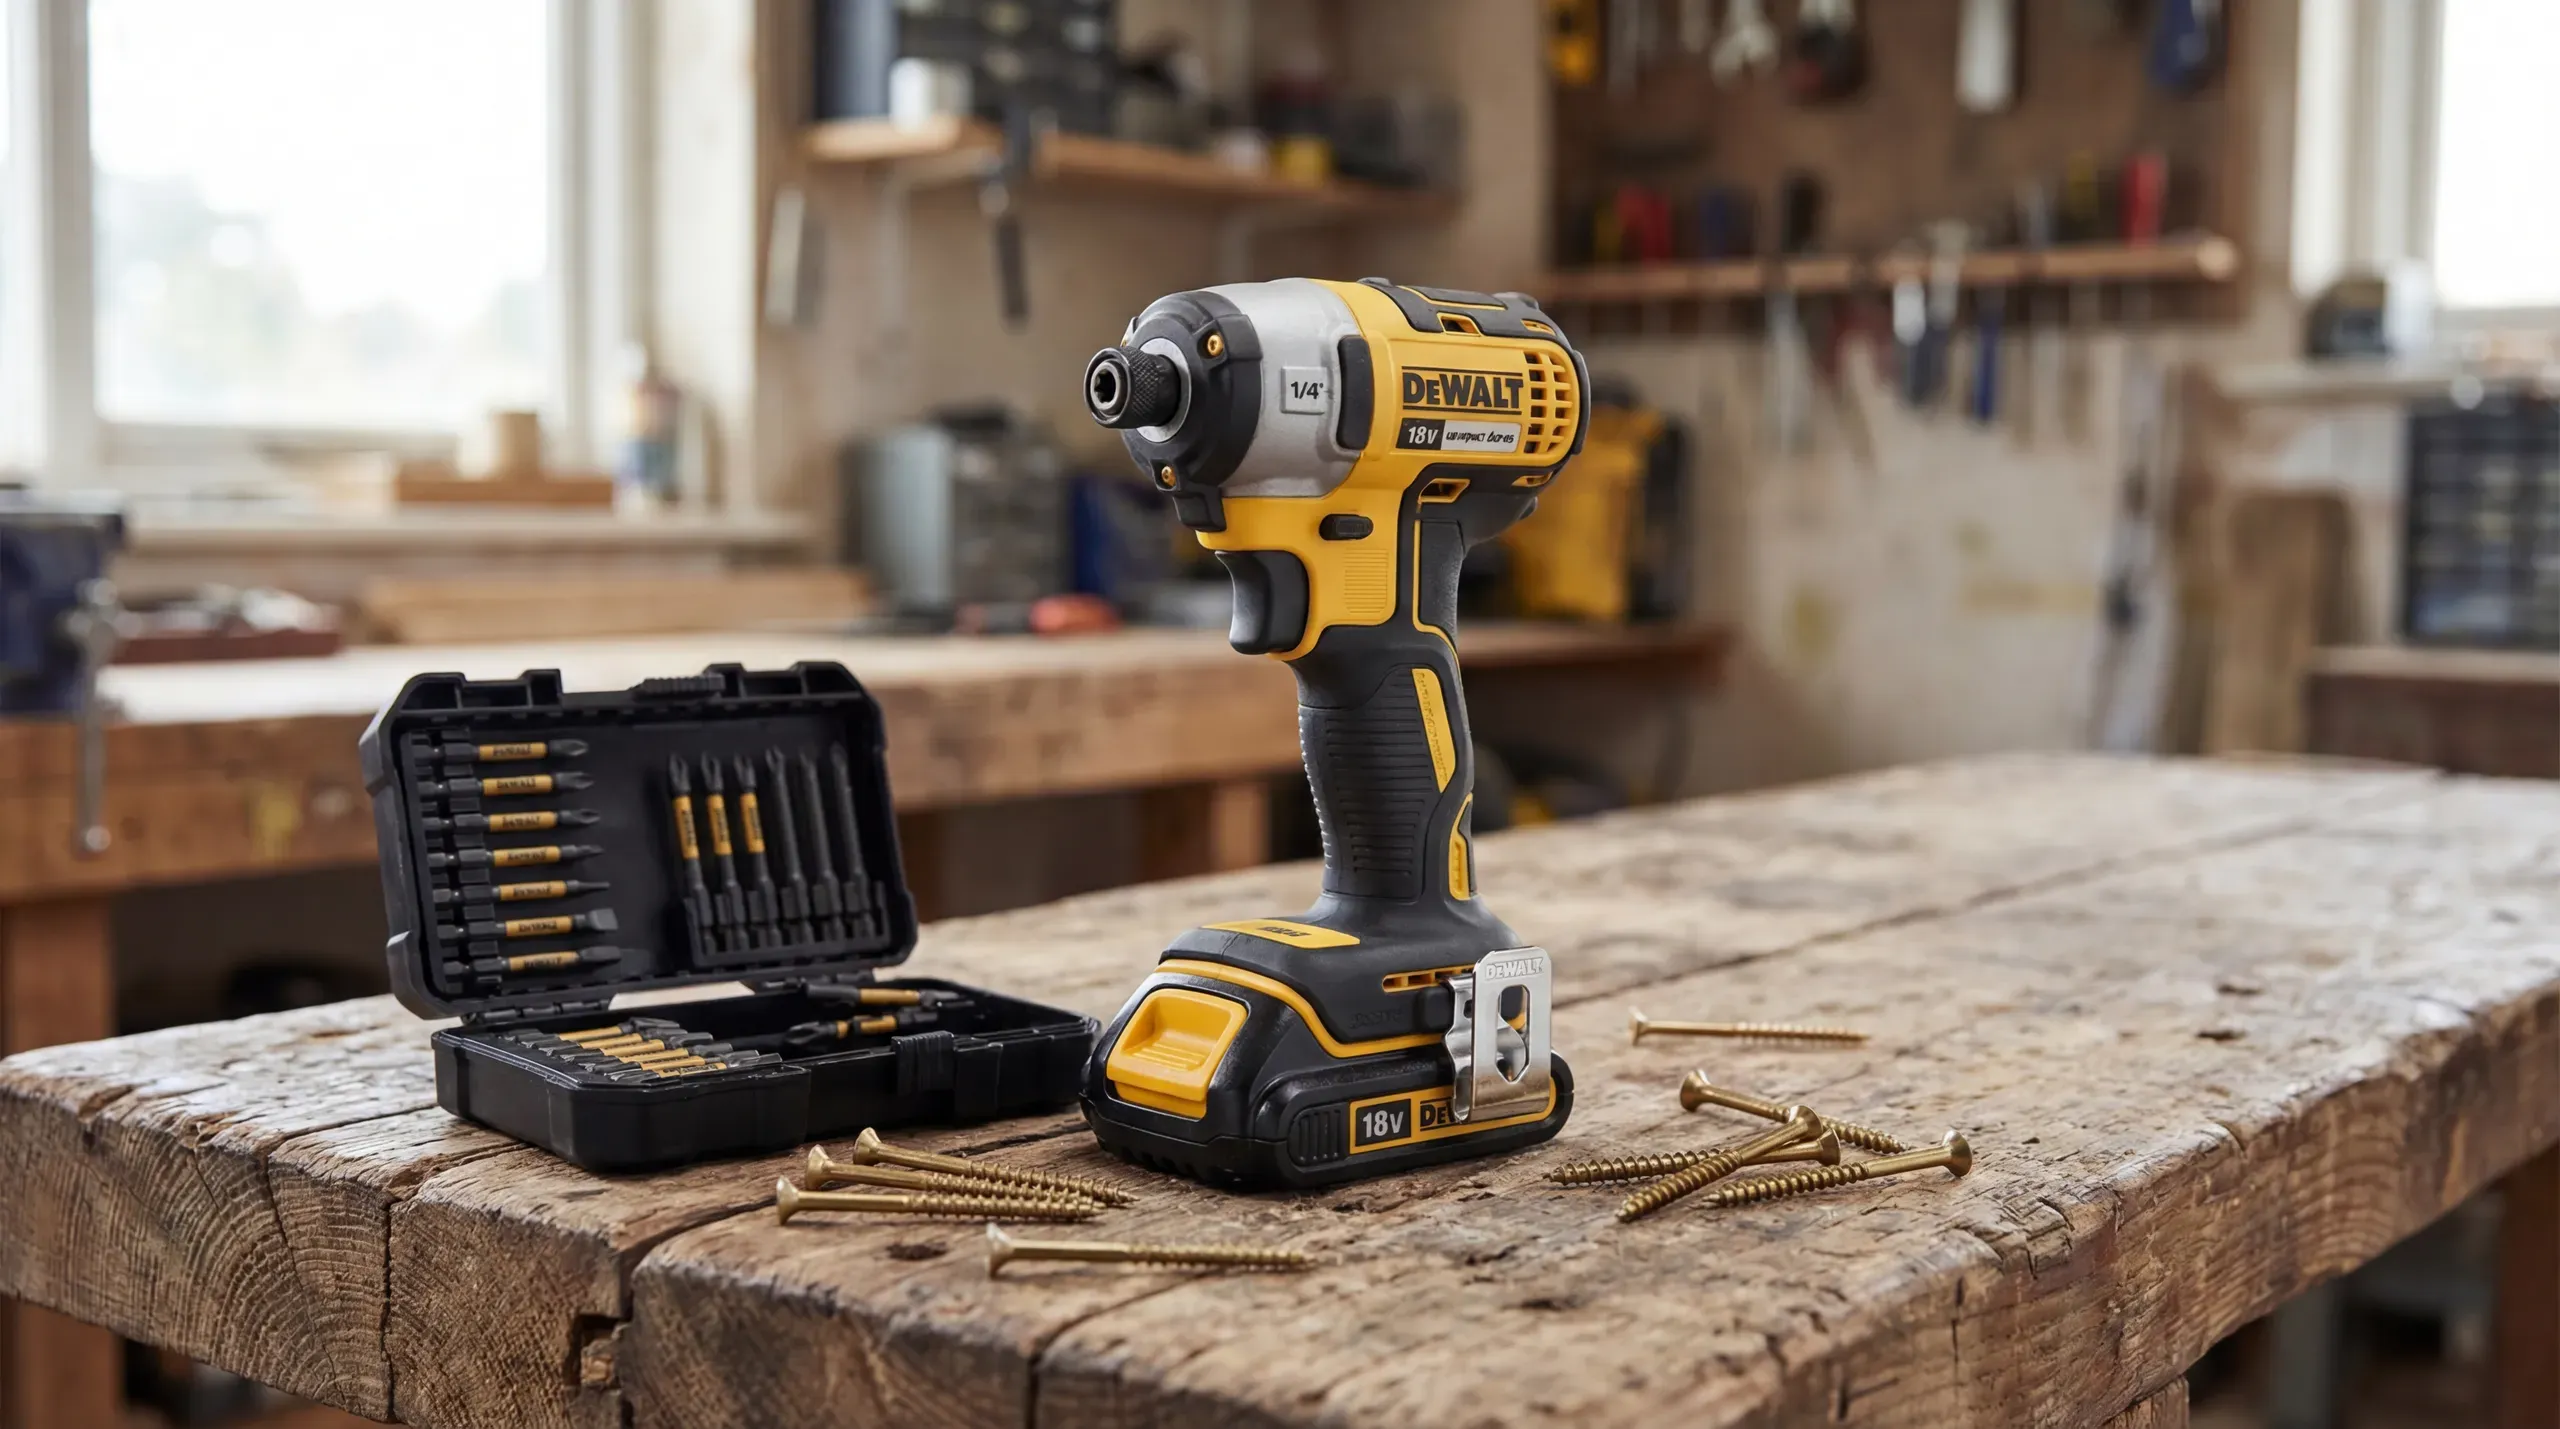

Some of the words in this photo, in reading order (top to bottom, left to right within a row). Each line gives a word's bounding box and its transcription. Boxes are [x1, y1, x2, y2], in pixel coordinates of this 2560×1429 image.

[1402, 372, 1524, 409] DEWALT
[1408, 426, 1439, 445] 18V
[1485, 957, 1543, 980] DEWALT
[1362, 1109, 1404, 1139] 18V
[1420, 1102, 1454, 1127] DE
